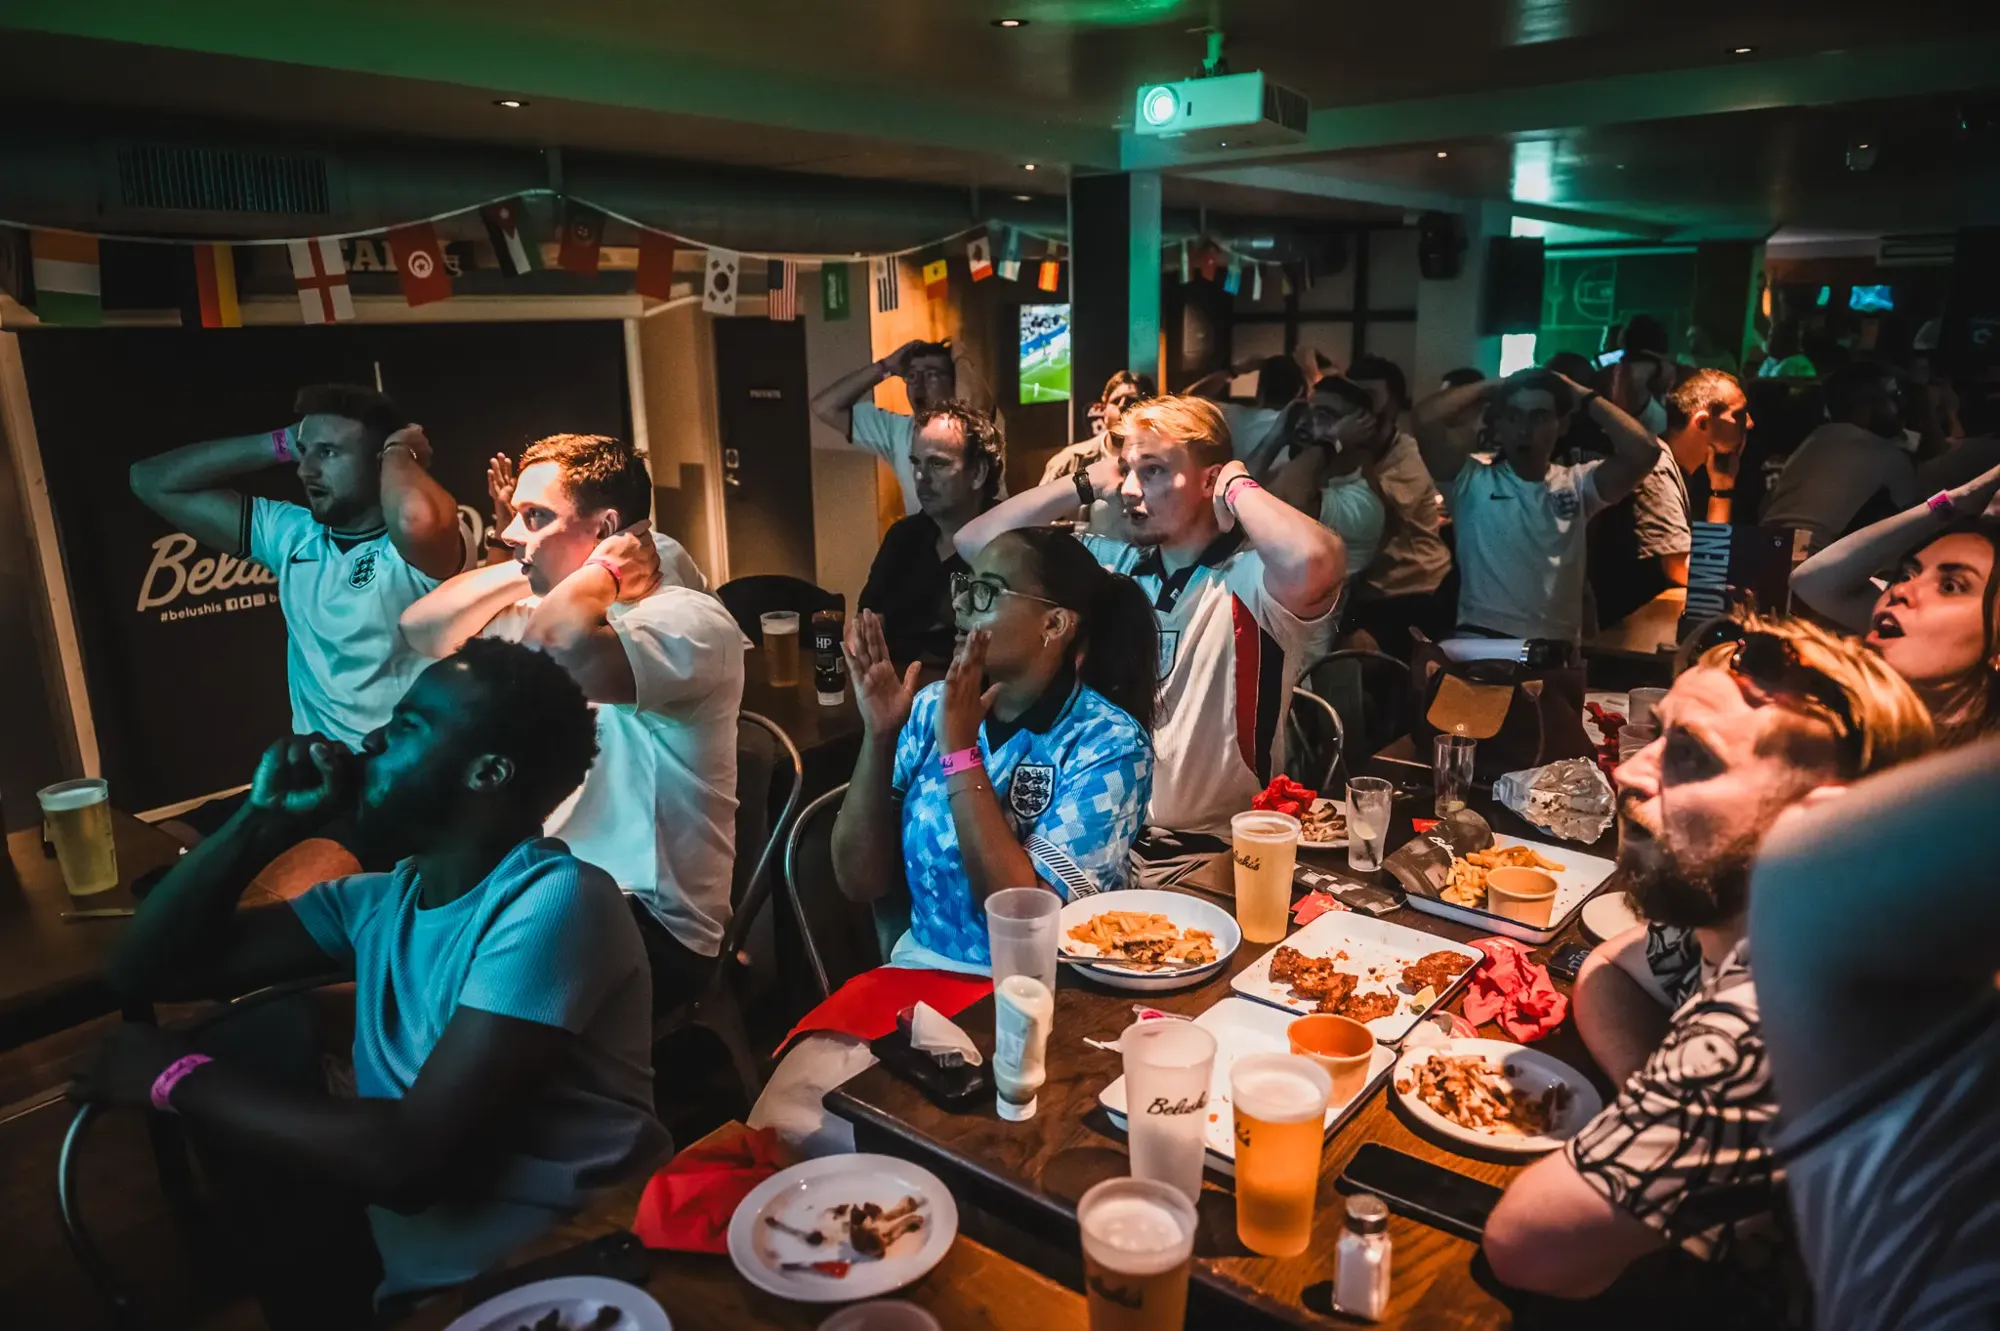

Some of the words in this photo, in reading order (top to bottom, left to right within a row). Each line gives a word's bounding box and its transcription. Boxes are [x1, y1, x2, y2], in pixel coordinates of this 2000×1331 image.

[1687, 521, 1733, 592] MENU
[160, 602, 222, 623] #belushis
[816, 637, 832, 649] HP
